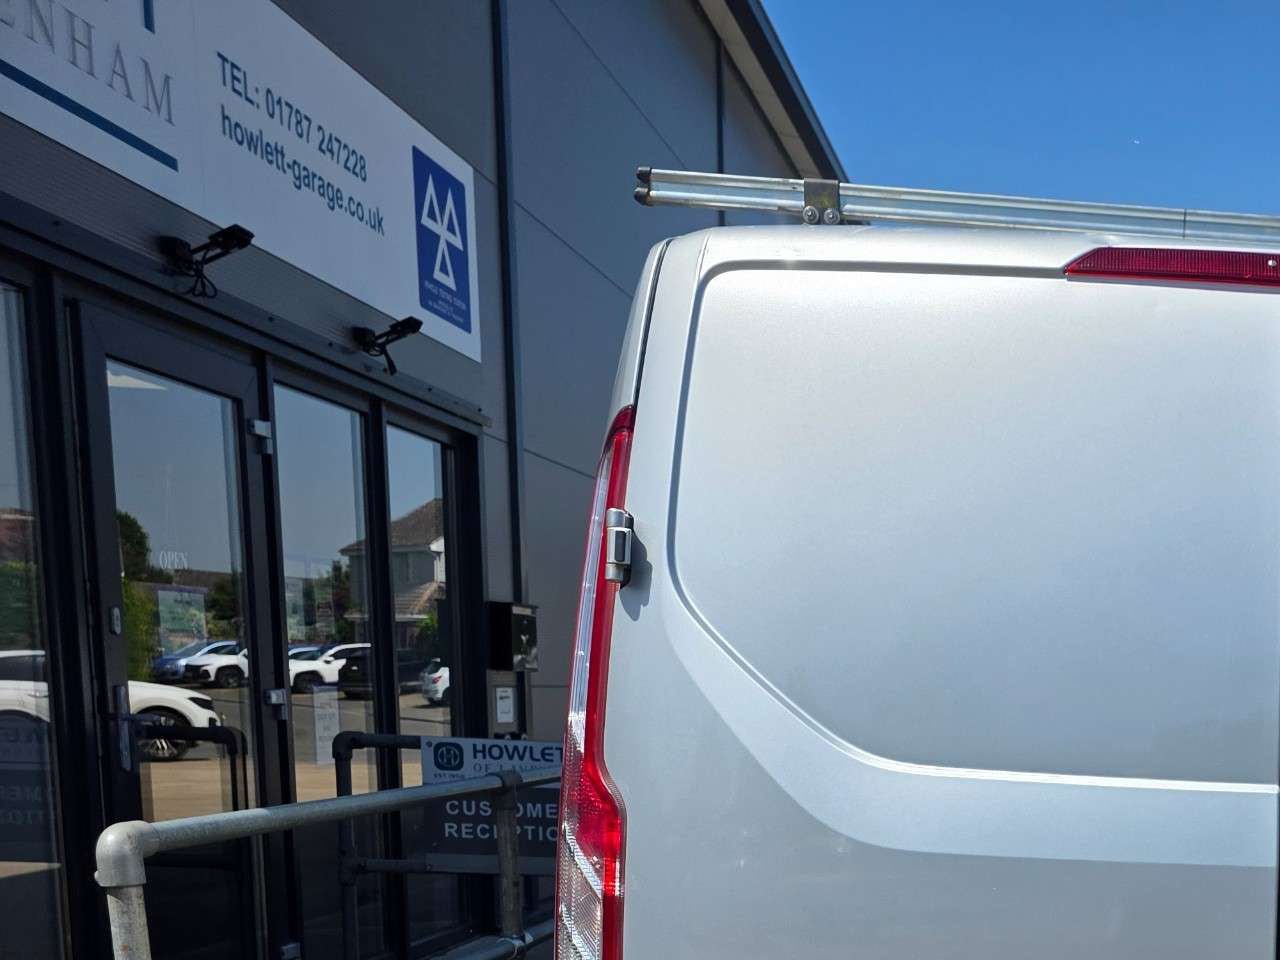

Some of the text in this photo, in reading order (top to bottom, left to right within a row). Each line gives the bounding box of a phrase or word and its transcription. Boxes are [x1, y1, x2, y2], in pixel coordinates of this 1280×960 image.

[0, 0, 176, 126] NHAM
[217, 51, 367, 183] TEL: 01787 247228
[221, 103, 385, 236] howlett-garage.co.uk
[159, 551, 188, 569] OPEN
